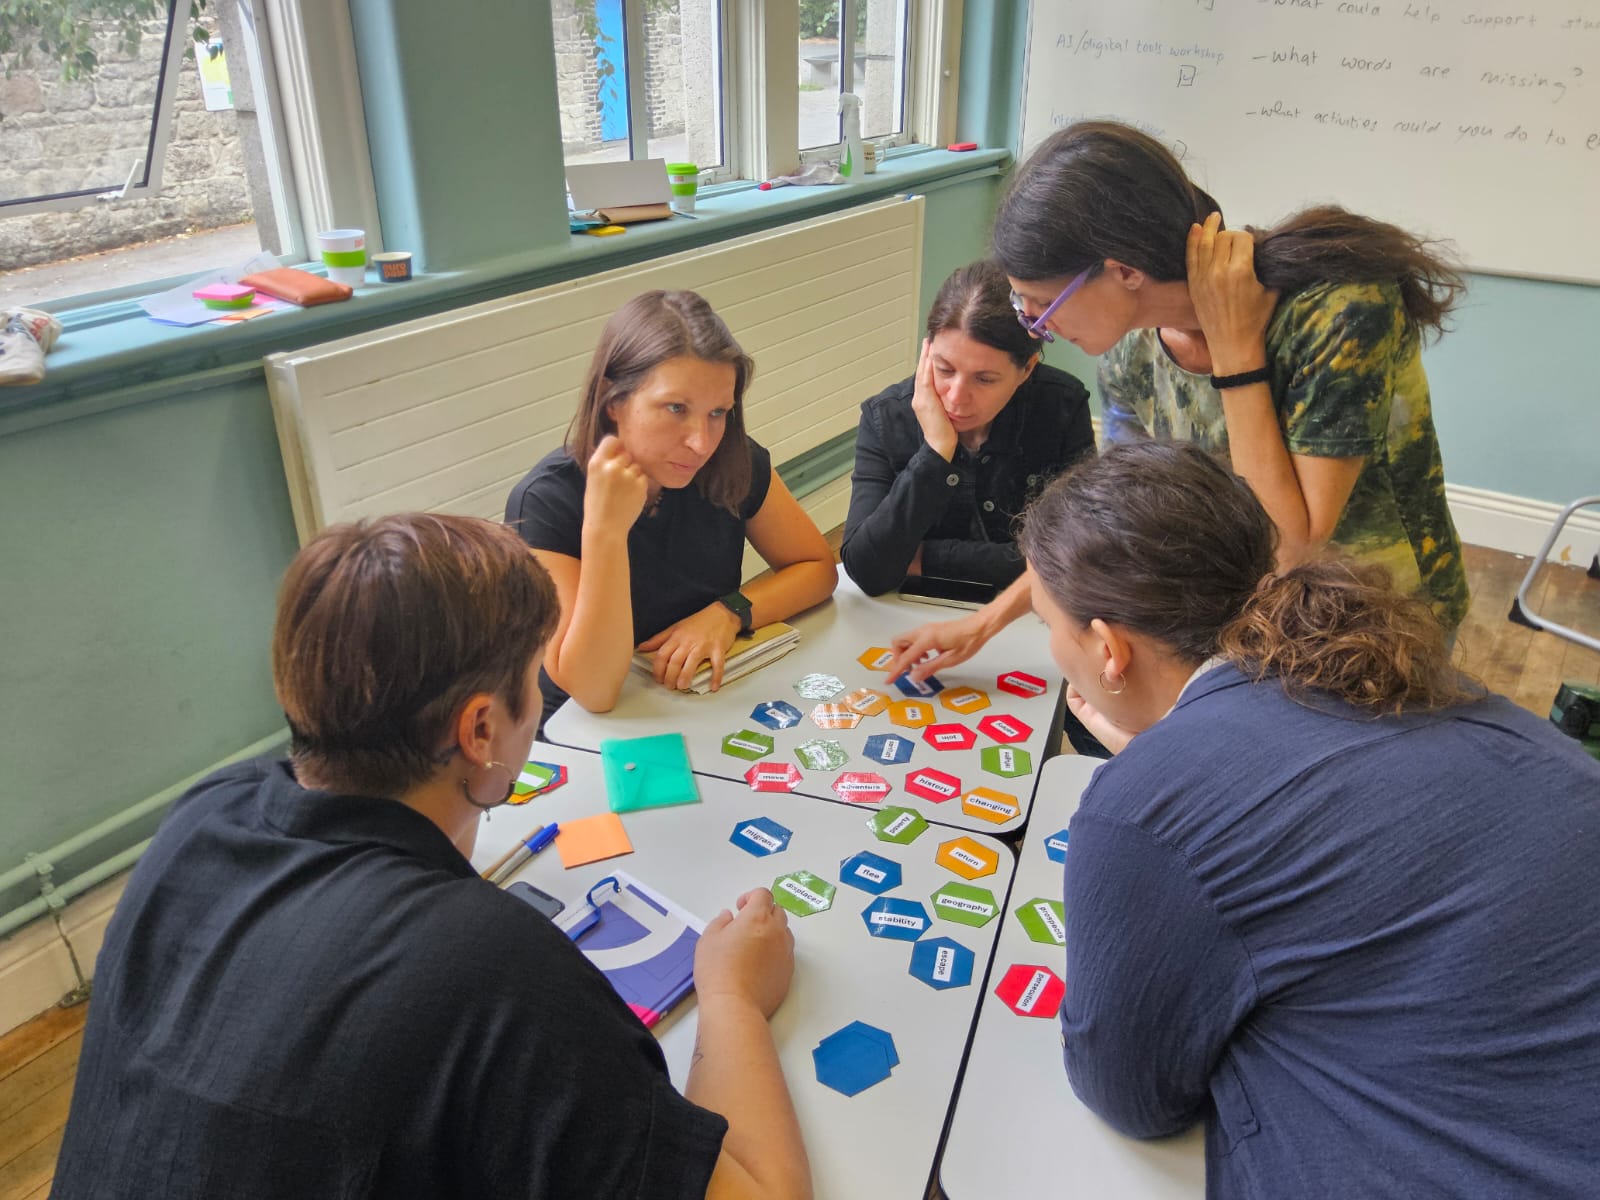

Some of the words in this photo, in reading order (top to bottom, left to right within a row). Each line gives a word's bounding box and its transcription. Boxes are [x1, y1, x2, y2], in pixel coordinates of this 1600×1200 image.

[1338, 2, 1381, 16] could
[1403, 4, 1440, 24] help
[1462, 14, 1537, 29] support
[1341, 56, 1392, 71] words
[1420, 66, 1451, 79] are
[1480, 66, 1583, 104] missing?
[1394, 120, 1441, 133] could
[1455, 125, 1493, 144] you
[1504, 125, 1528, 141] do
[1545, 128, 1566, 144] to
[919, 777, 950, 793] history
[969, 797, 1012, 815] changing
[888, 816, 911, 834] poverty
[745, 828, 777, 848] migrant
[954, 850, 979, 867] return
[862, 868, 880, 879] flee
[785, 882, 824, 905] displaced
[941, 897, 989, 913] geography
[878, 915, 917, 927] stability
[1039, 906, 1065, 939] prospects
[940, 950, 948, 976] escape
[1023, 973, 1045, 1007] persecution
